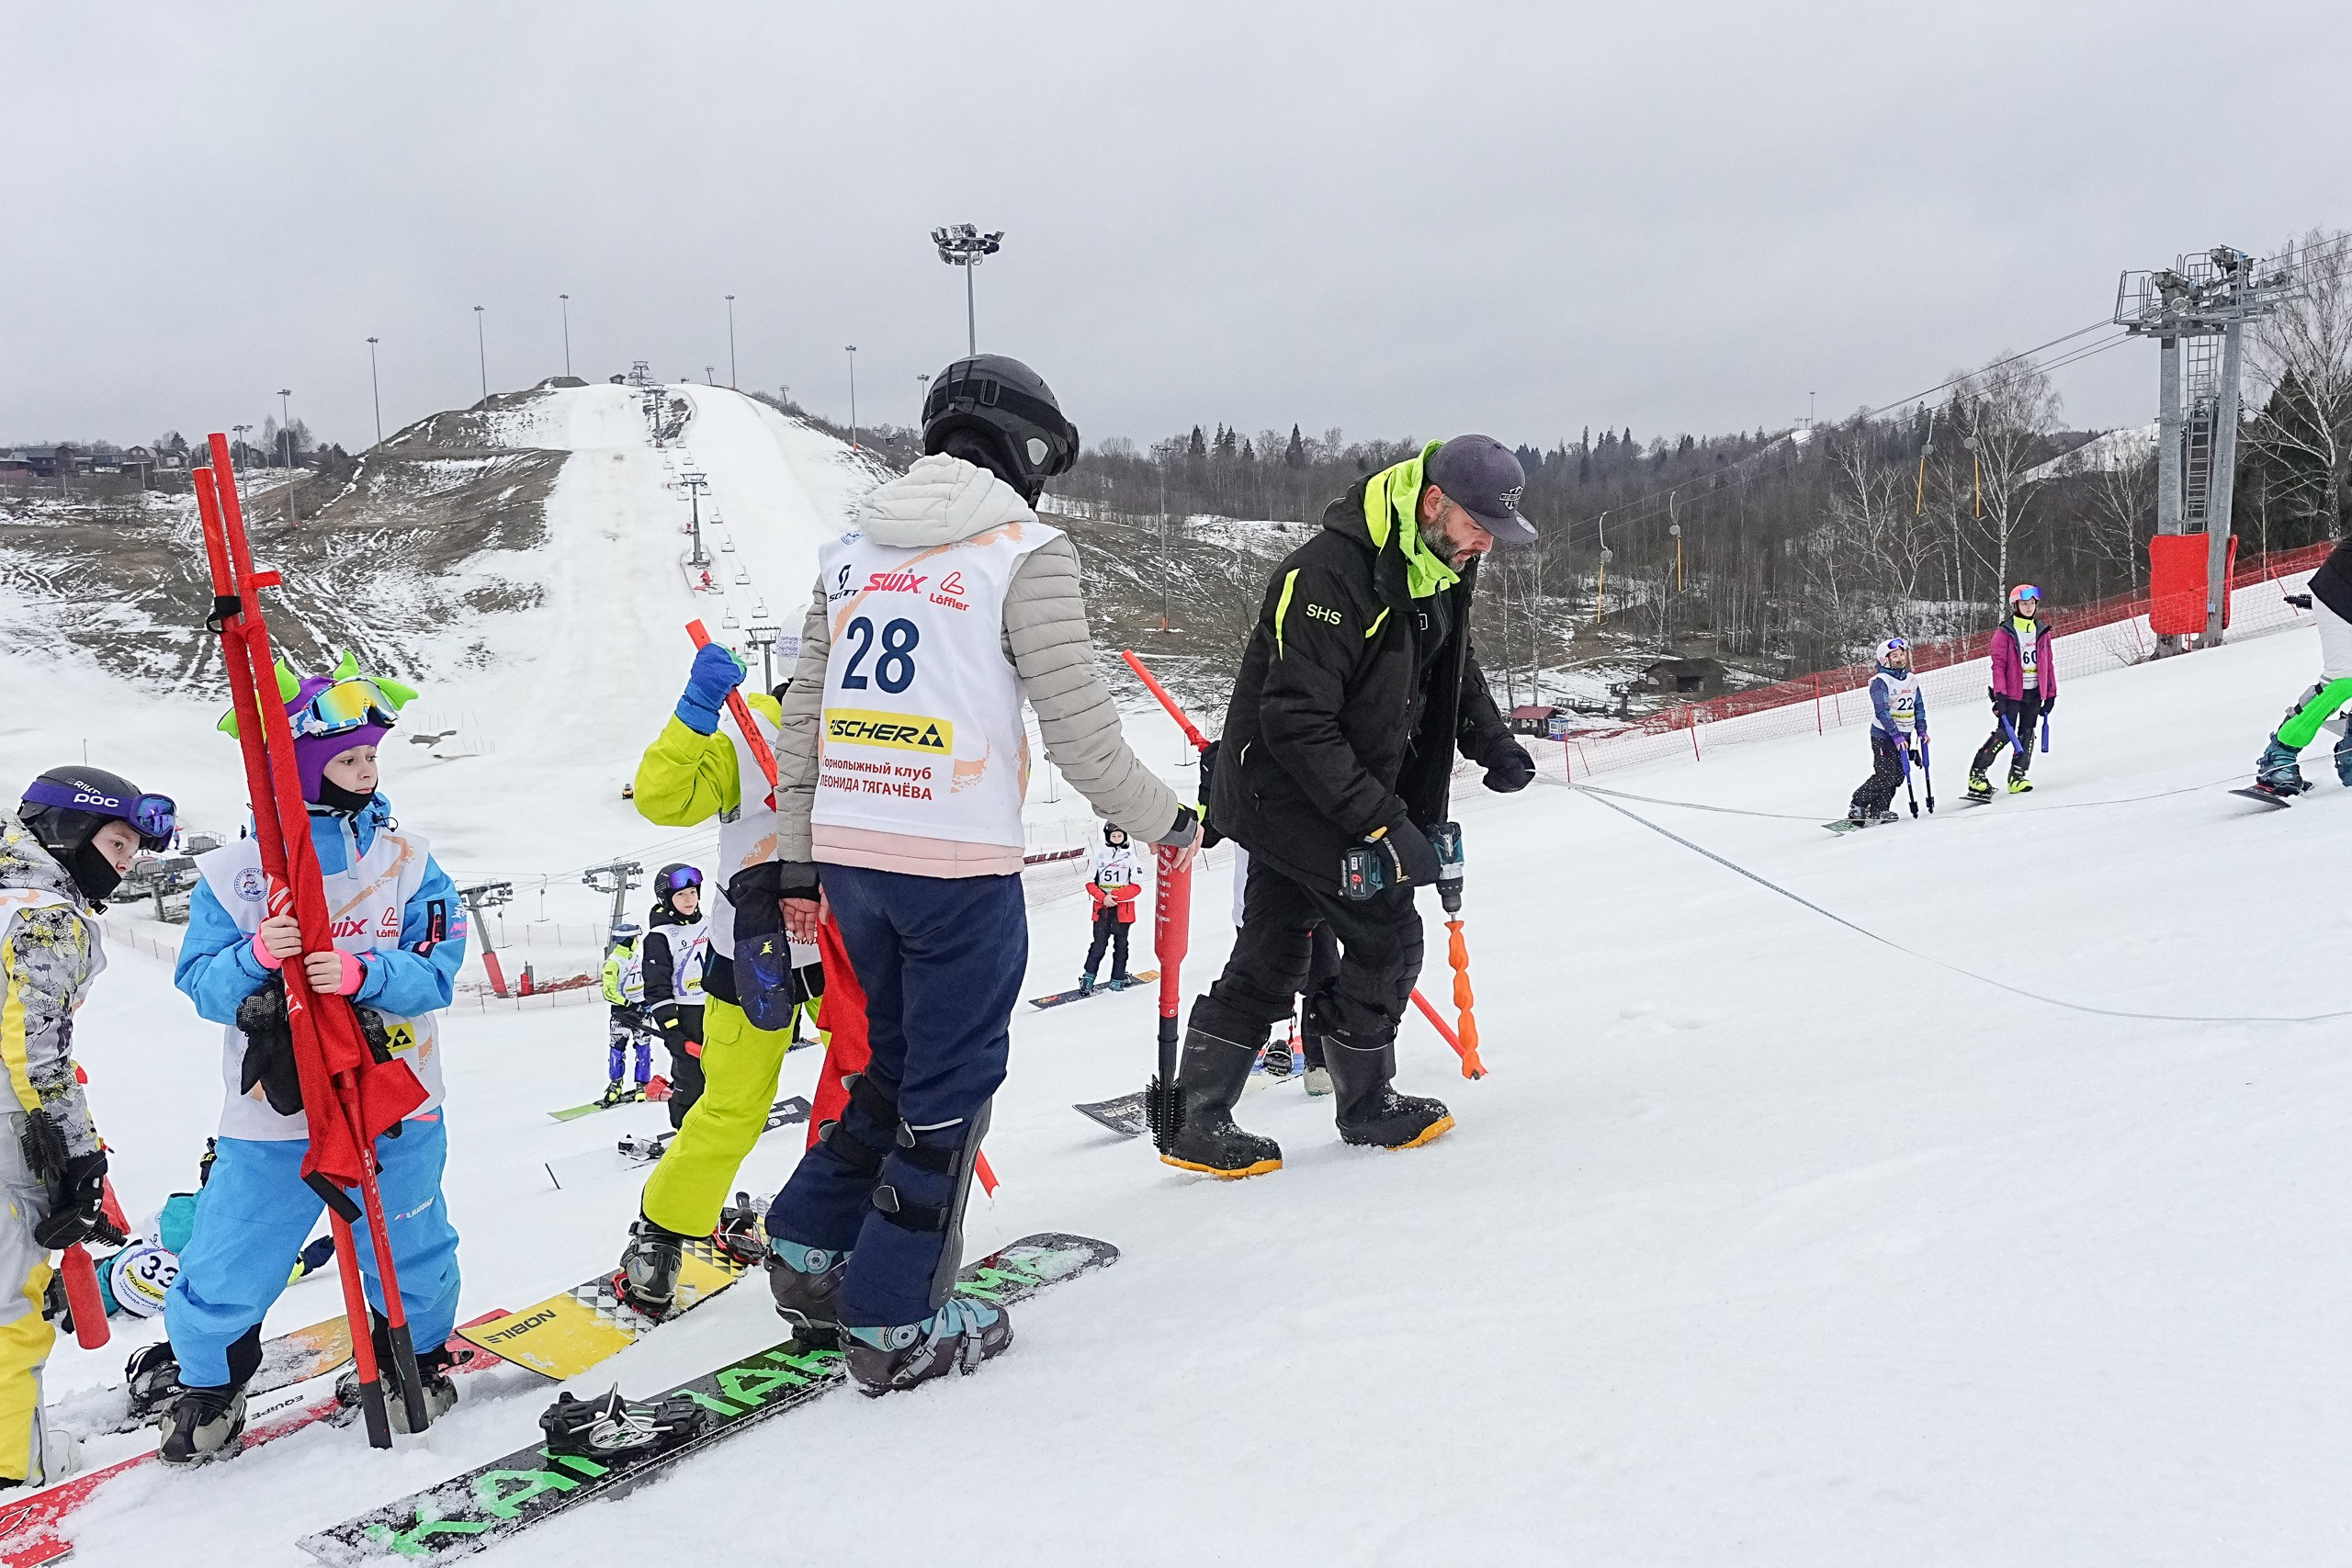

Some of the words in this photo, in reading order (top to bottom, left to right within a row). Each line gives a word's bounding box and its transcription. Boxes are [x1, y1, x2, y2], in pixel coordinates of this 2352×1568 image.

[1306, 604, 1342, 625] SHS
[841, 615, 920, 694] 28
[1897, 697, 1914, 711] 22
[894, 766, 932, 782] клуб
[862, 780, 933, 801] ТЯГАЧЁВА
[1104, 870, 1119, 883] 51
[141, 1256, 179, 1288] 33
[483, 1309, 557, 1344] NOBILE
[251, 1394, 304, 1420] EQUIPE
